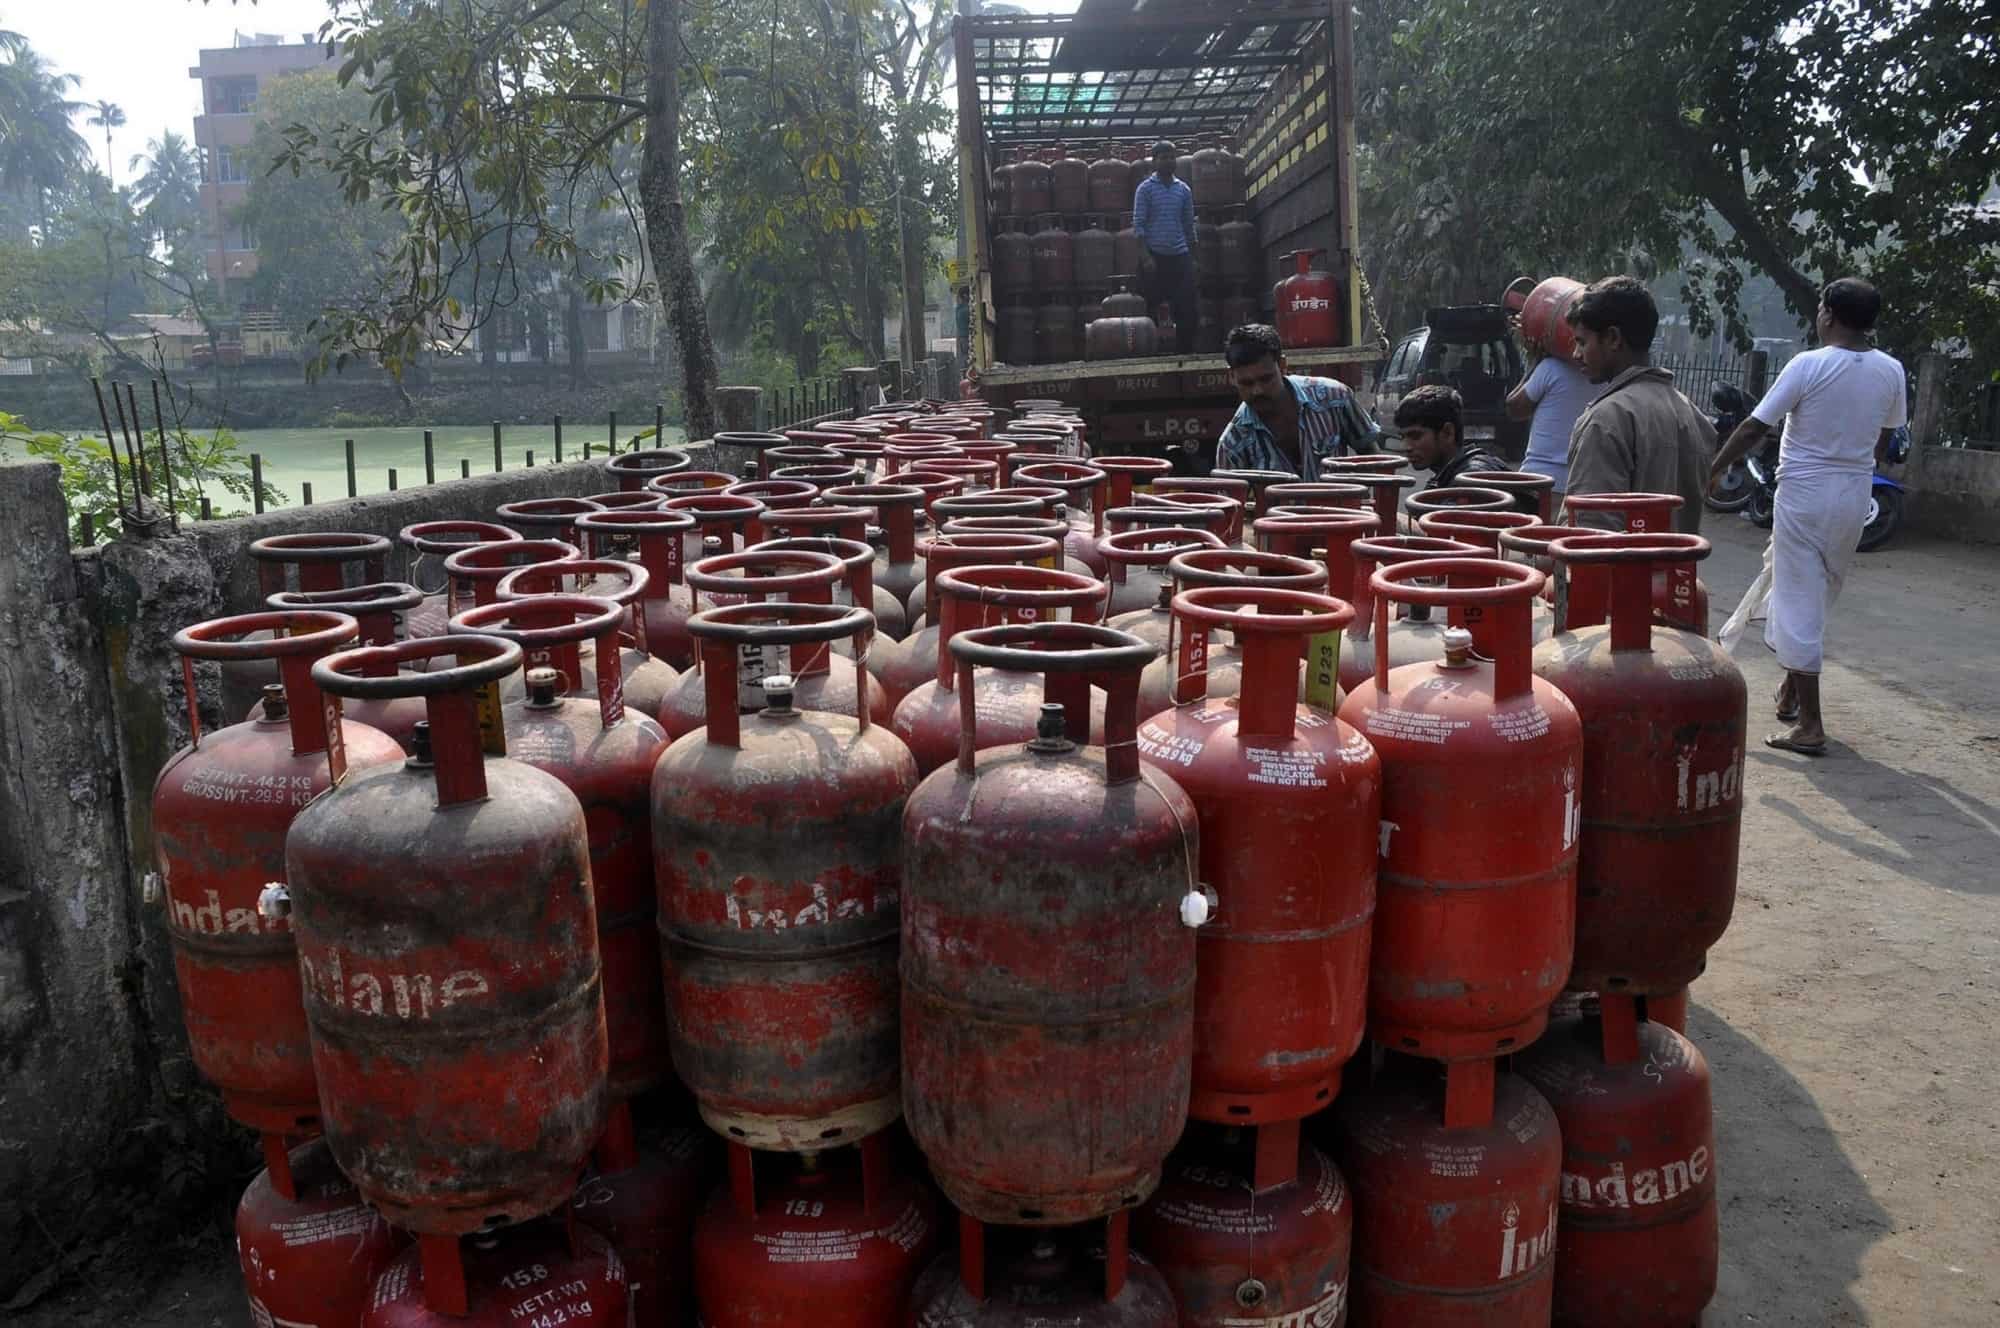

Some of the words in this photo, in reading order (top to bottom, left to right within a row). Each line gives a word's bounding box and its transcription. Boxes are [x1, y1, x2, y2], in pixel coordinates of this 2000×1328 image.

[1026, 380, 1073, 396] SLOW
[1144, 418, 1208, 438] L.P.G.
[784, 1199, 824, 1217] 15.9
[501, 1263, 549, 1289] 15.8
